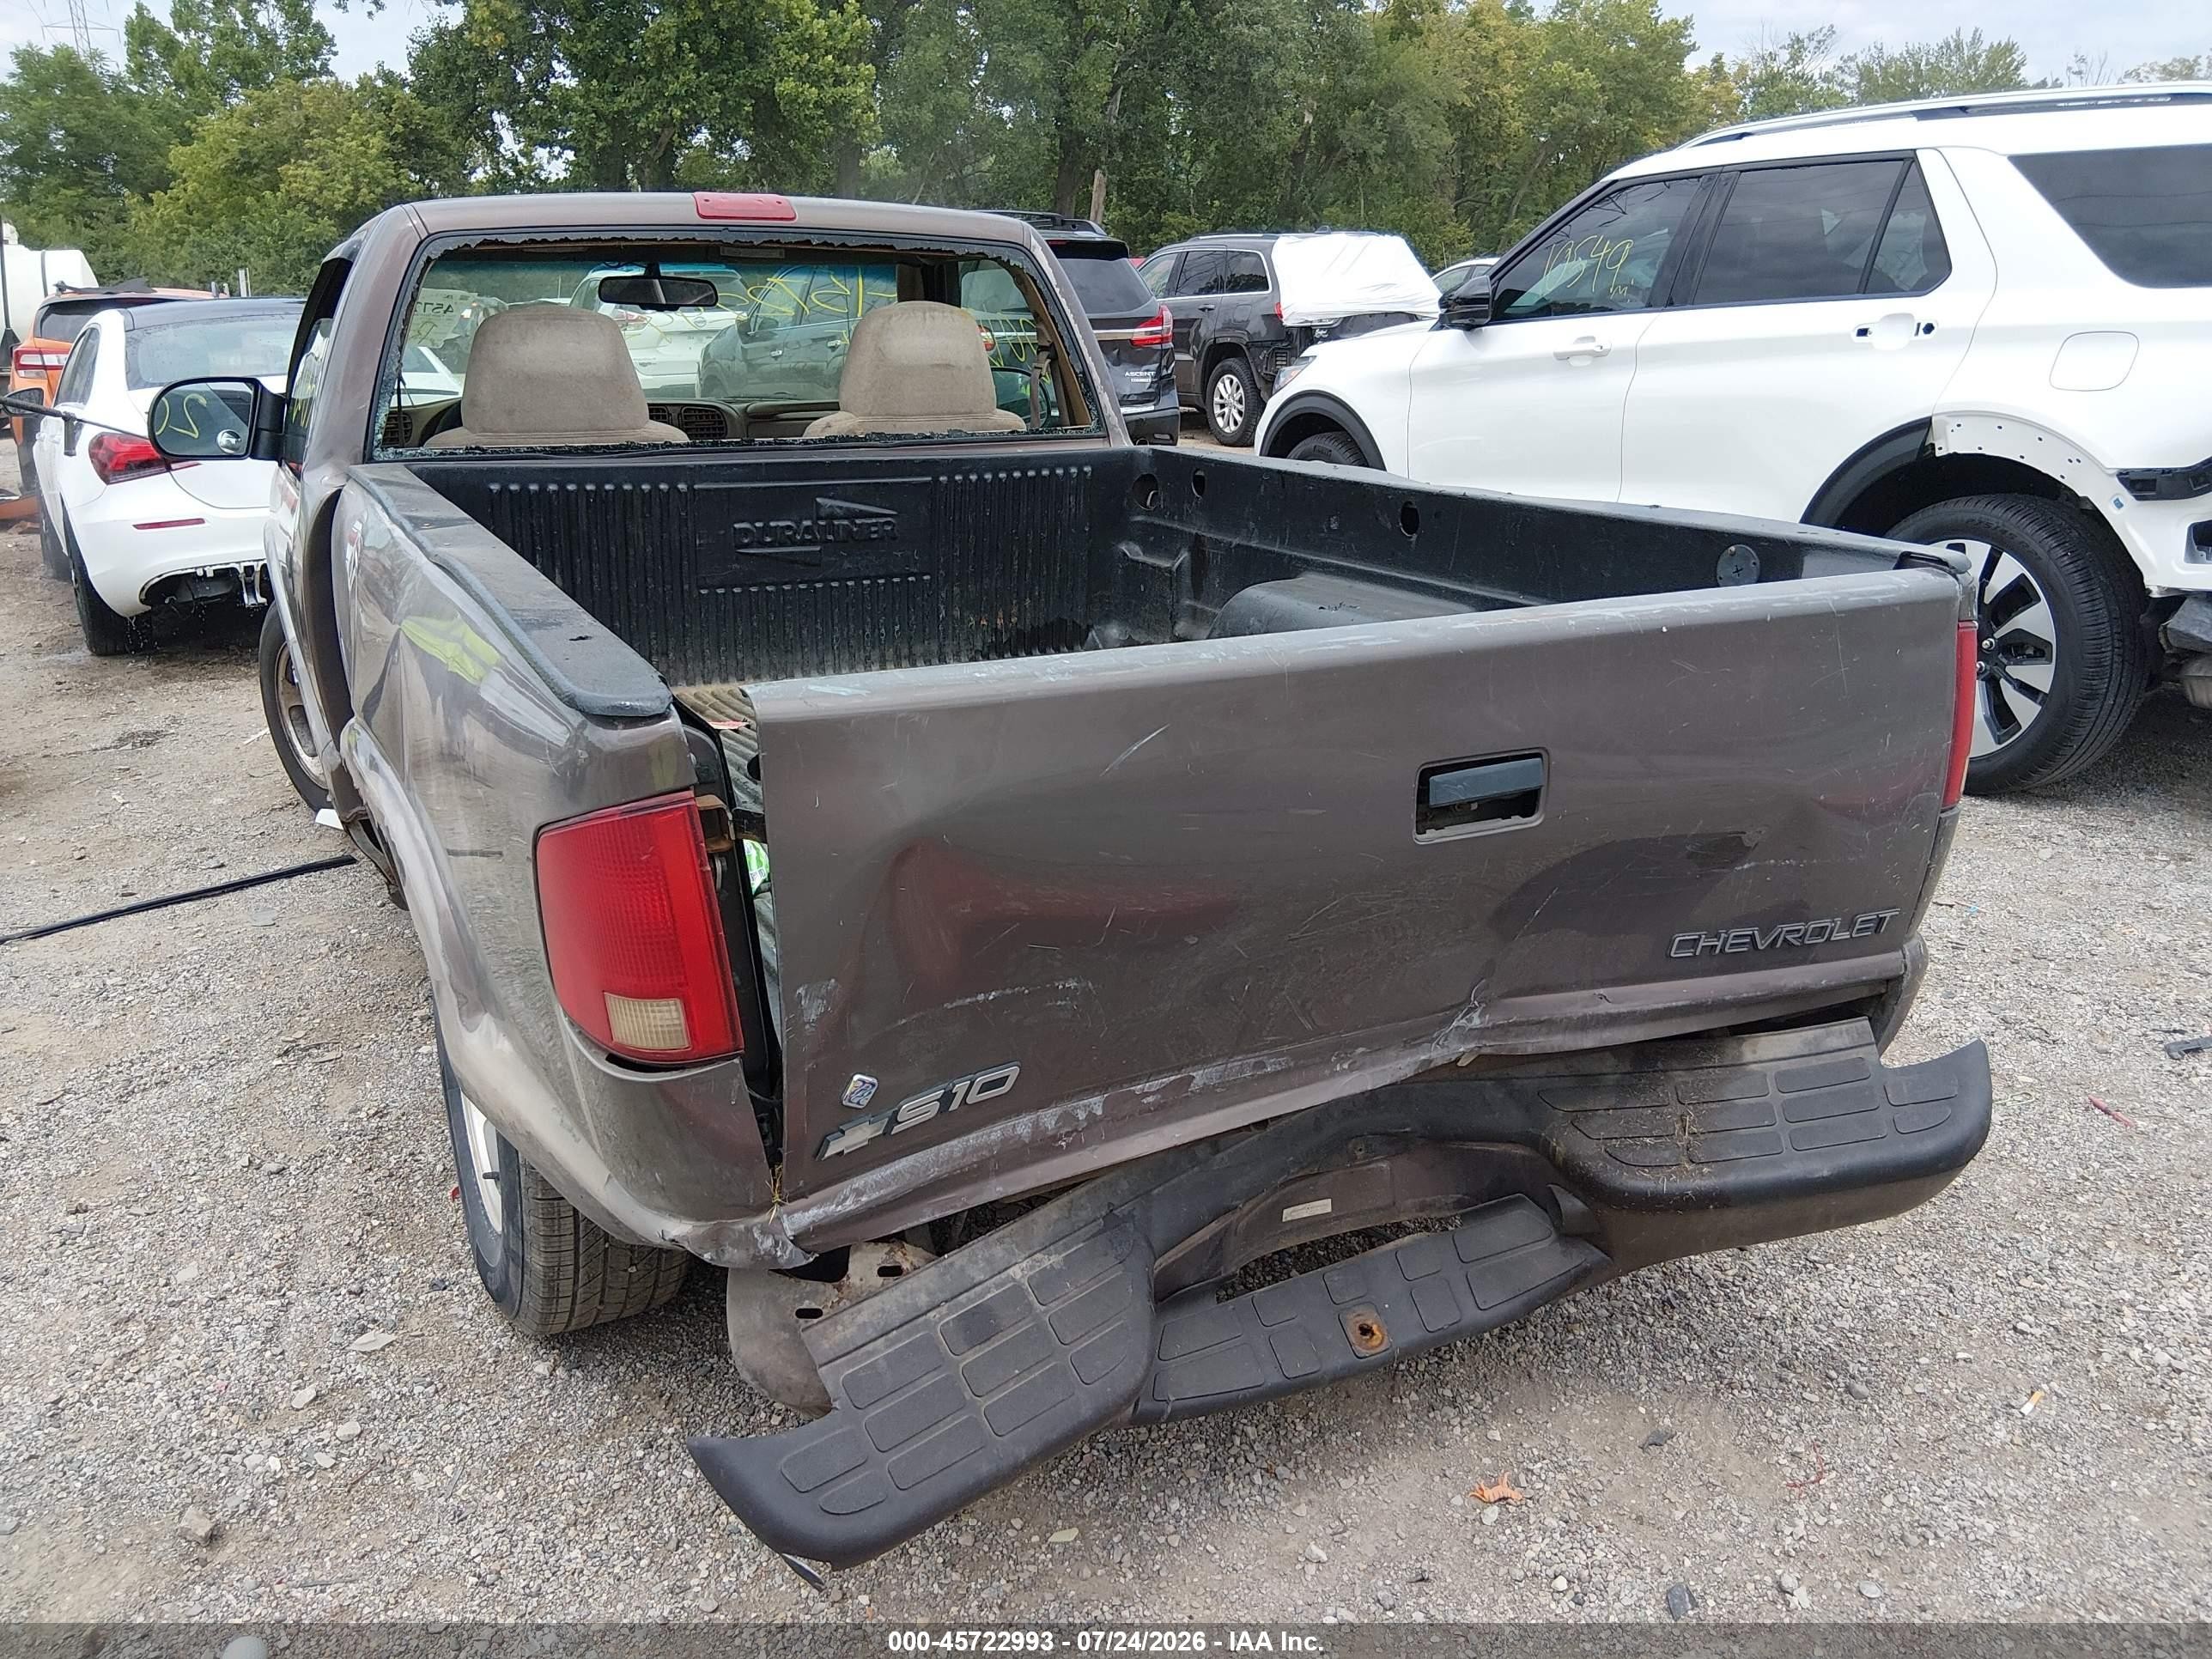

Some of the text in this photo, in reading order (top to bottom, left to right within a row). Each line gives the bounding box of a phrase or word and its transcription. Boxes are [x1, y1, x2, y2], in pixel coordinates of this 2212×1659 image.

[732, 517, 898, 547] DURALINER
[1668, 908, 1901, 959] CHEVROLET
[889, 1063, 1021, 1136] S10
